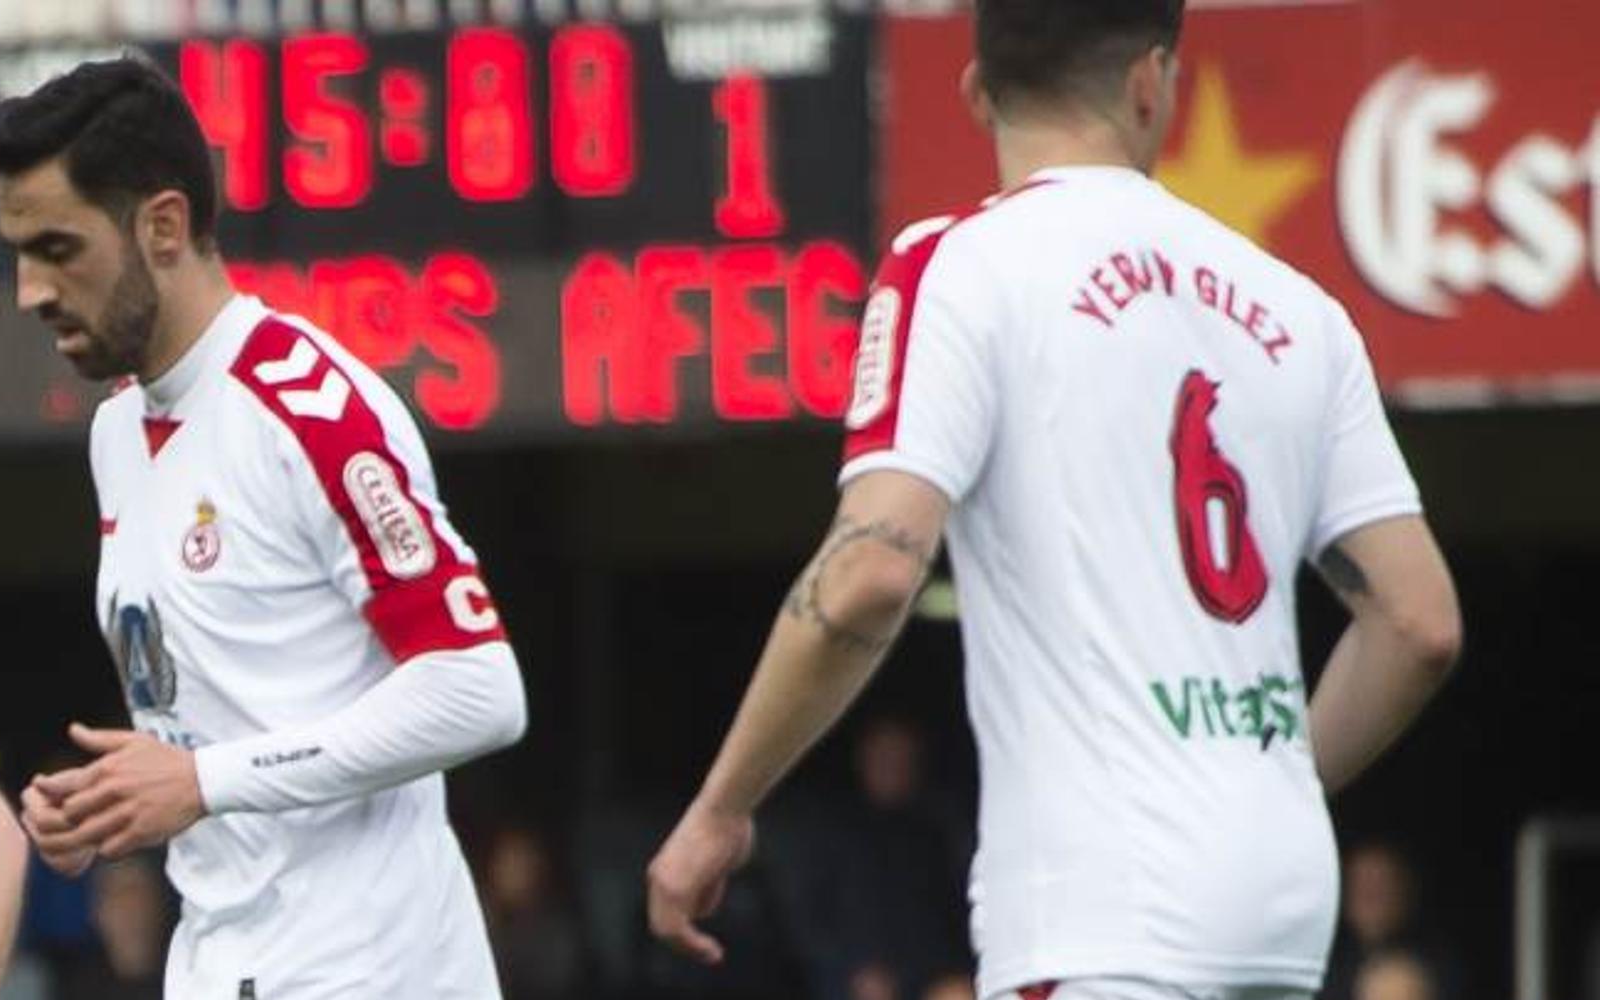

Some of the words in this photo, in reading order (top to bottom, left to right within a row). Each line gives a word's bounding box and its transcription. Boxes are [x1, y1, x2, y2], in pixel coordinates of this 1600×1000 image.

[712, 70, 784, 238] 1
[1336, 58, 1600, 318] Es
[1193, 265, 1293, 365] GLEZ
[1168, 366, 1269, 625] 6
[443, 575, 498, 633] C
